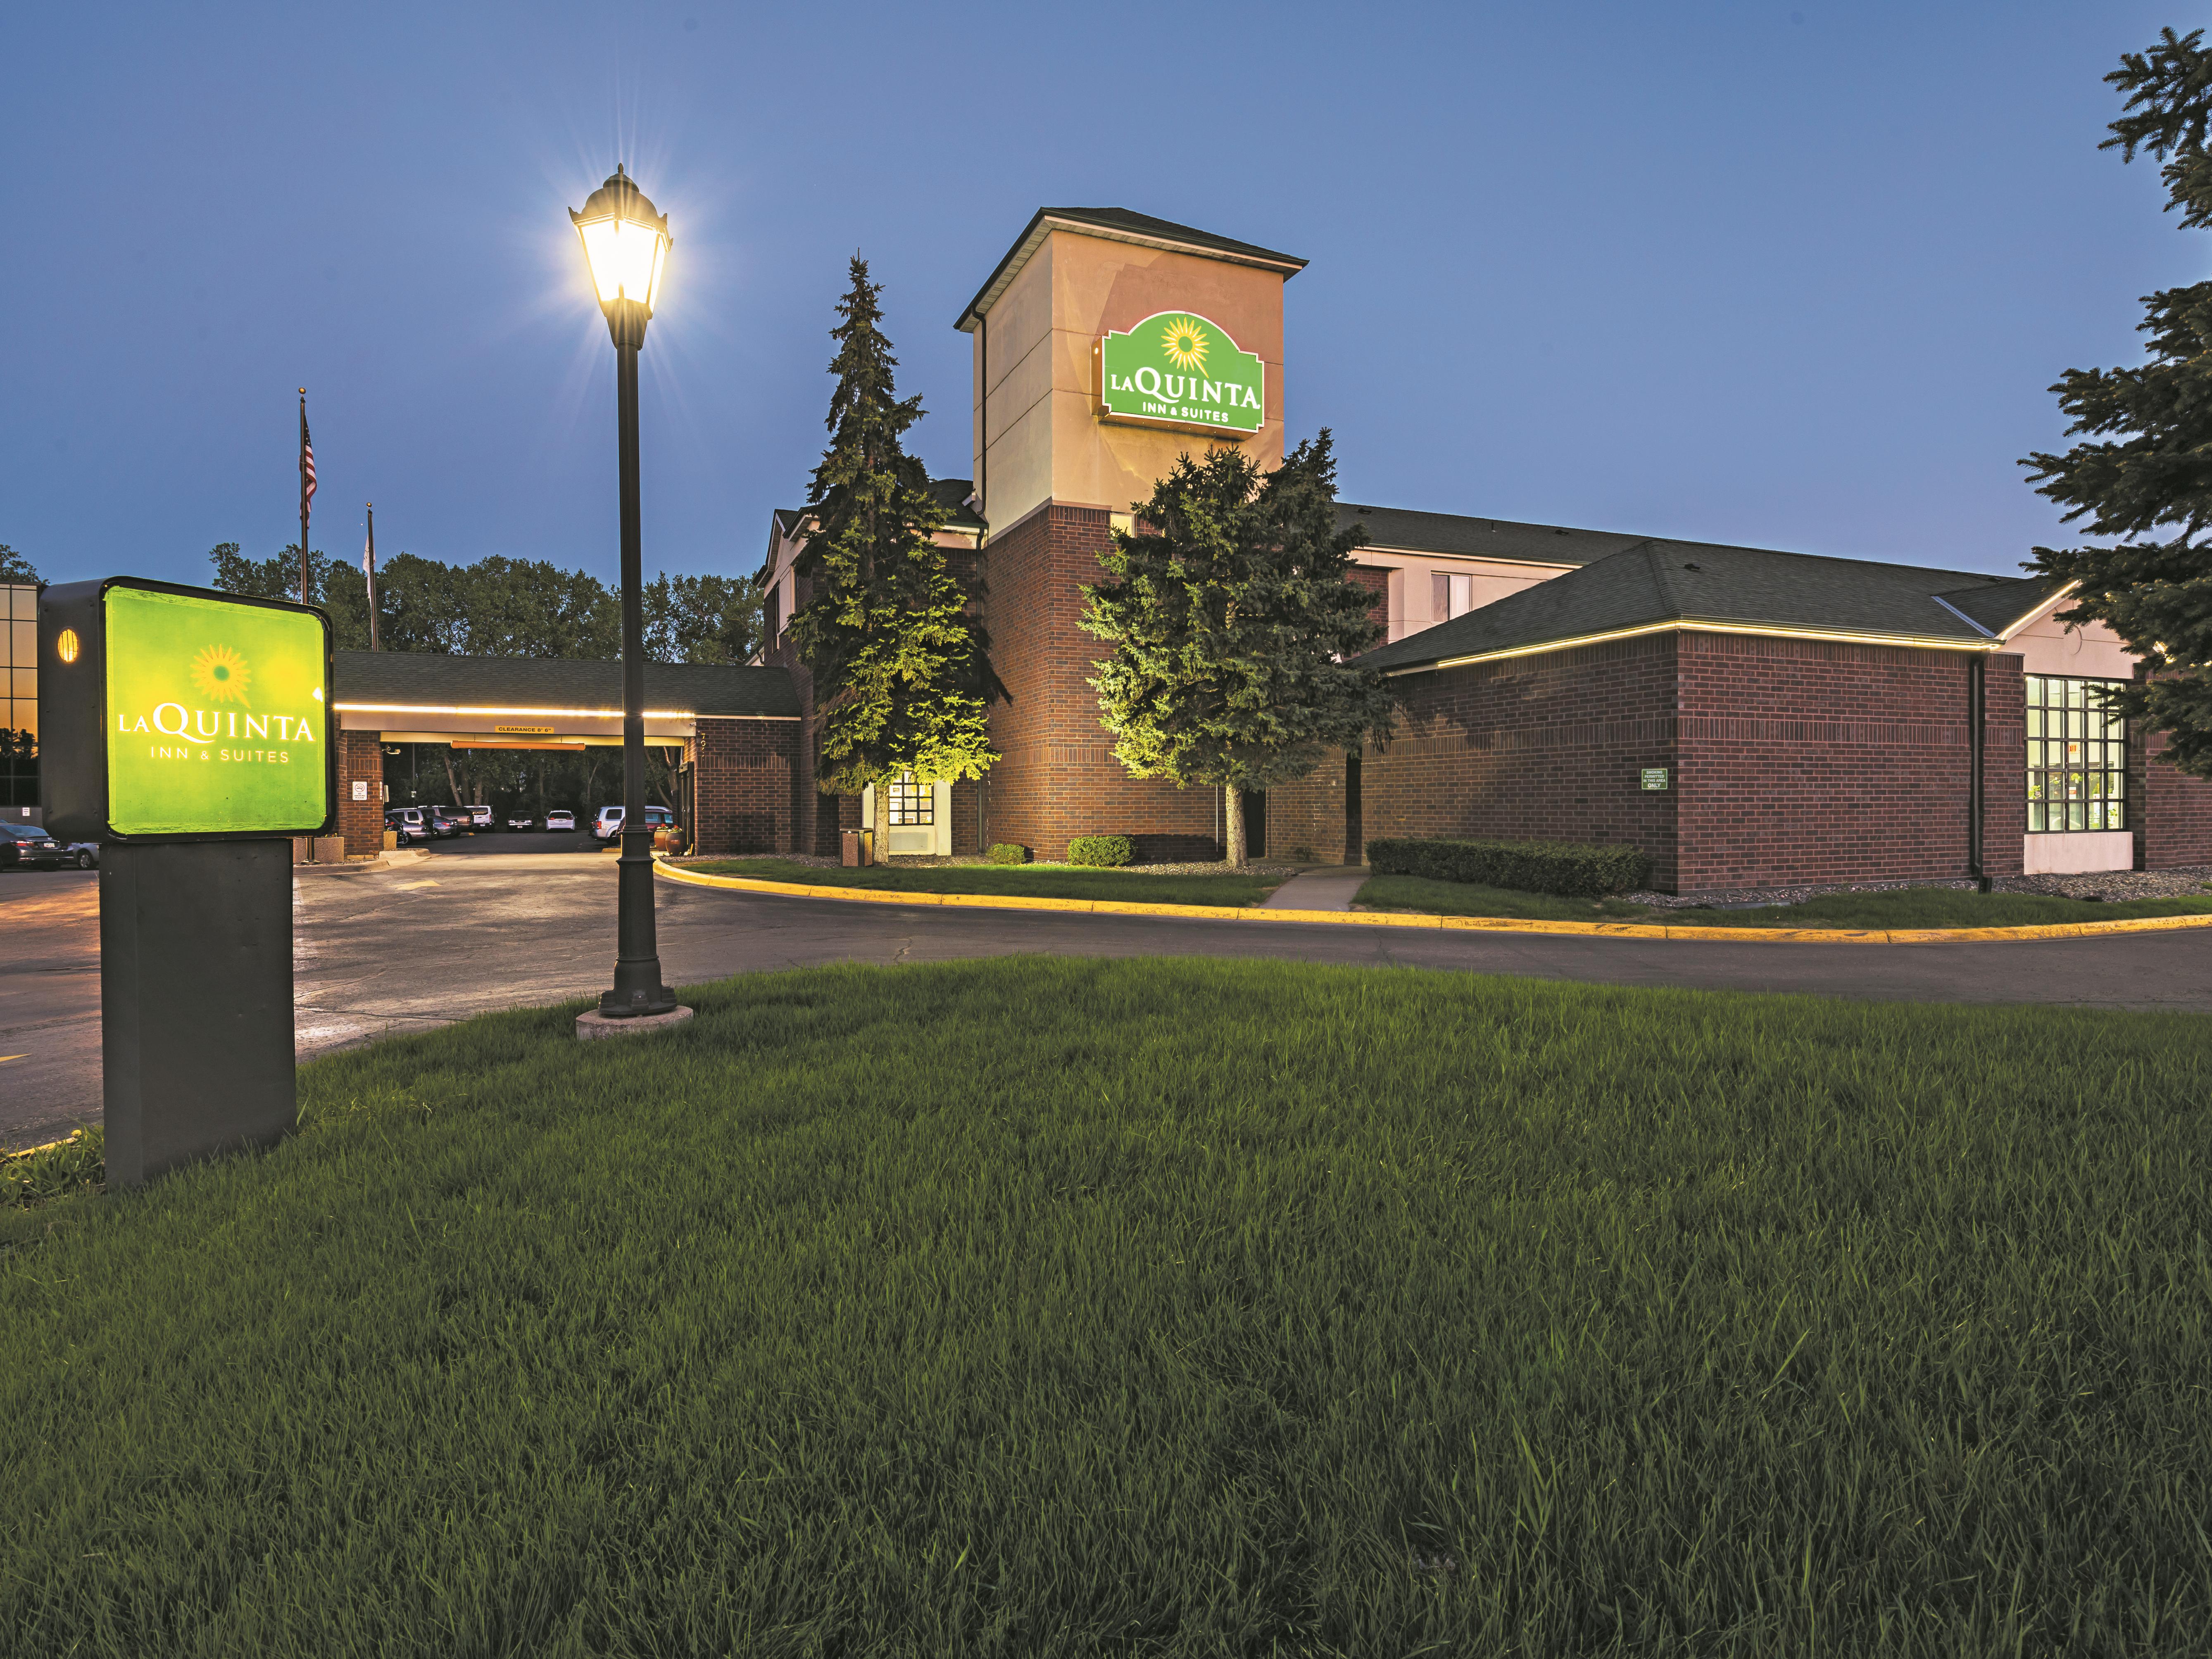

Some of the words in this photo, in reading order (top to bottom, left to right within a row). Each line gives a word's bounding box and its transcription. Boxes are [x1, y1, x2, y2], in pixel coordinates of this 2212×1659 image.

[1111, 374, 1134, 392] LA
[1135, 367, 1261, 409] QUINTA
[1143, 402, 1166, 414] INN
[1170, 406, 1177, 416] &
[1181, 406, 1229, 422] SUITES
[119, 714, 150, 732] LA
[152, 703, 316, 744] QUINTA
[151, 746, 188, 759] INN
[201, 751, 209, 761] &
[221, 749, 289, 763] SUITES
